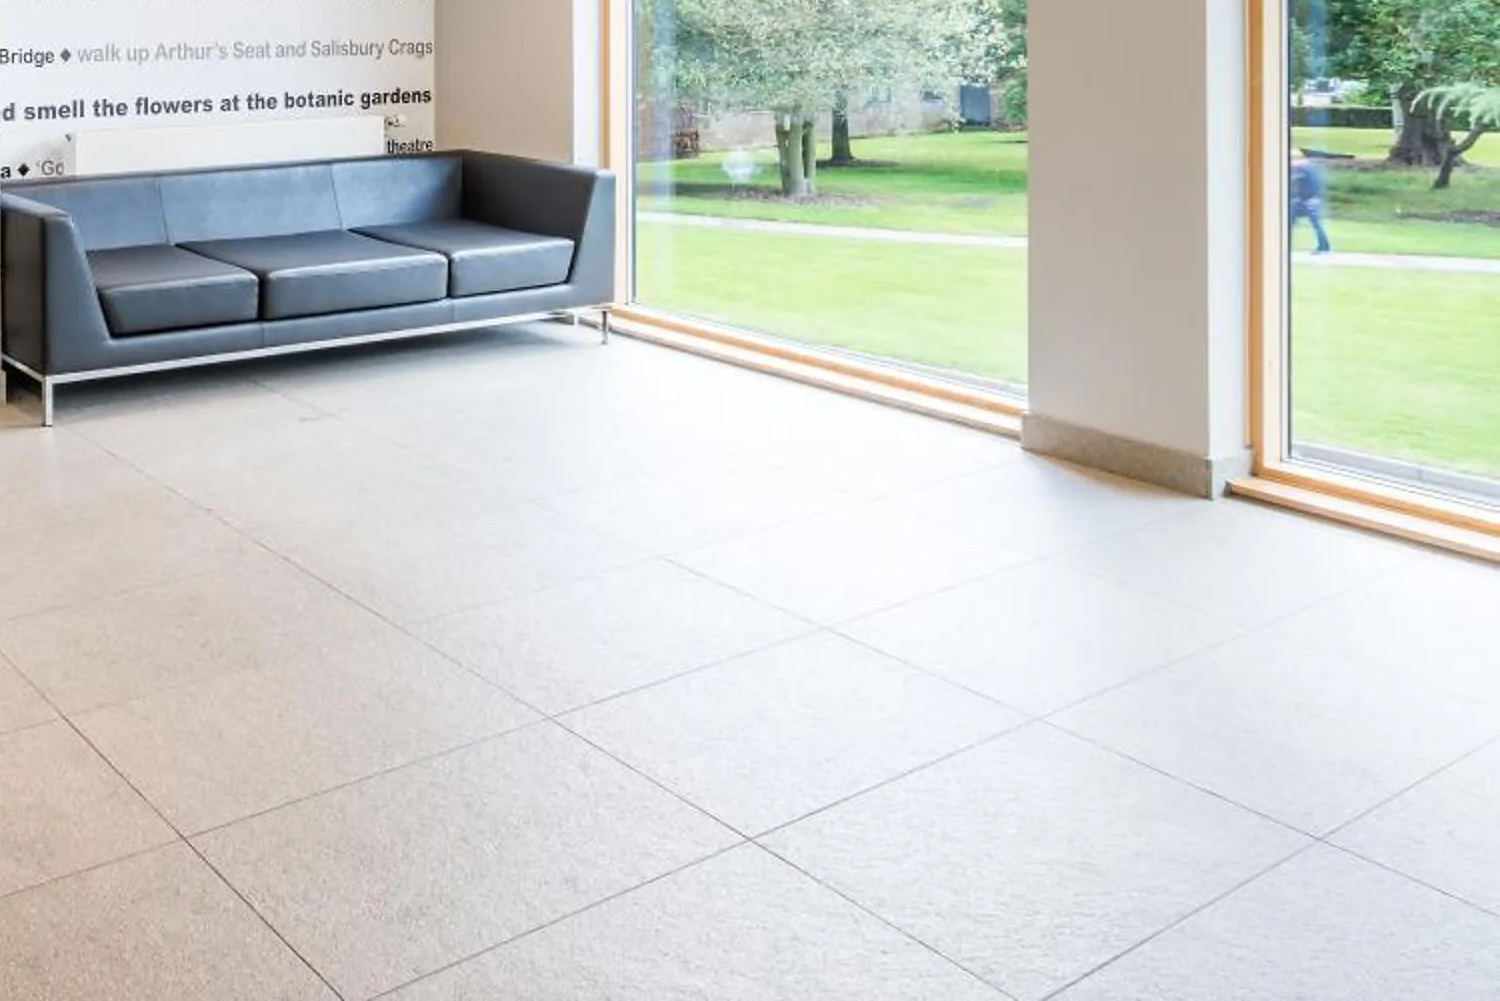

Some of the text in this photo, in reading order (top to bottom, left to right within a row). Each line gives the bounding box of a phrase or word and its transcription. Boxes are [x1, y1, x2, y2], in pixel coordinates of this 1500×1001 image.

[77, 37, 433, 67] walk up Arthur's Seat and Salisbury Crags
[24, 87, 431, 120] smell the flowers at the botanic gardens
